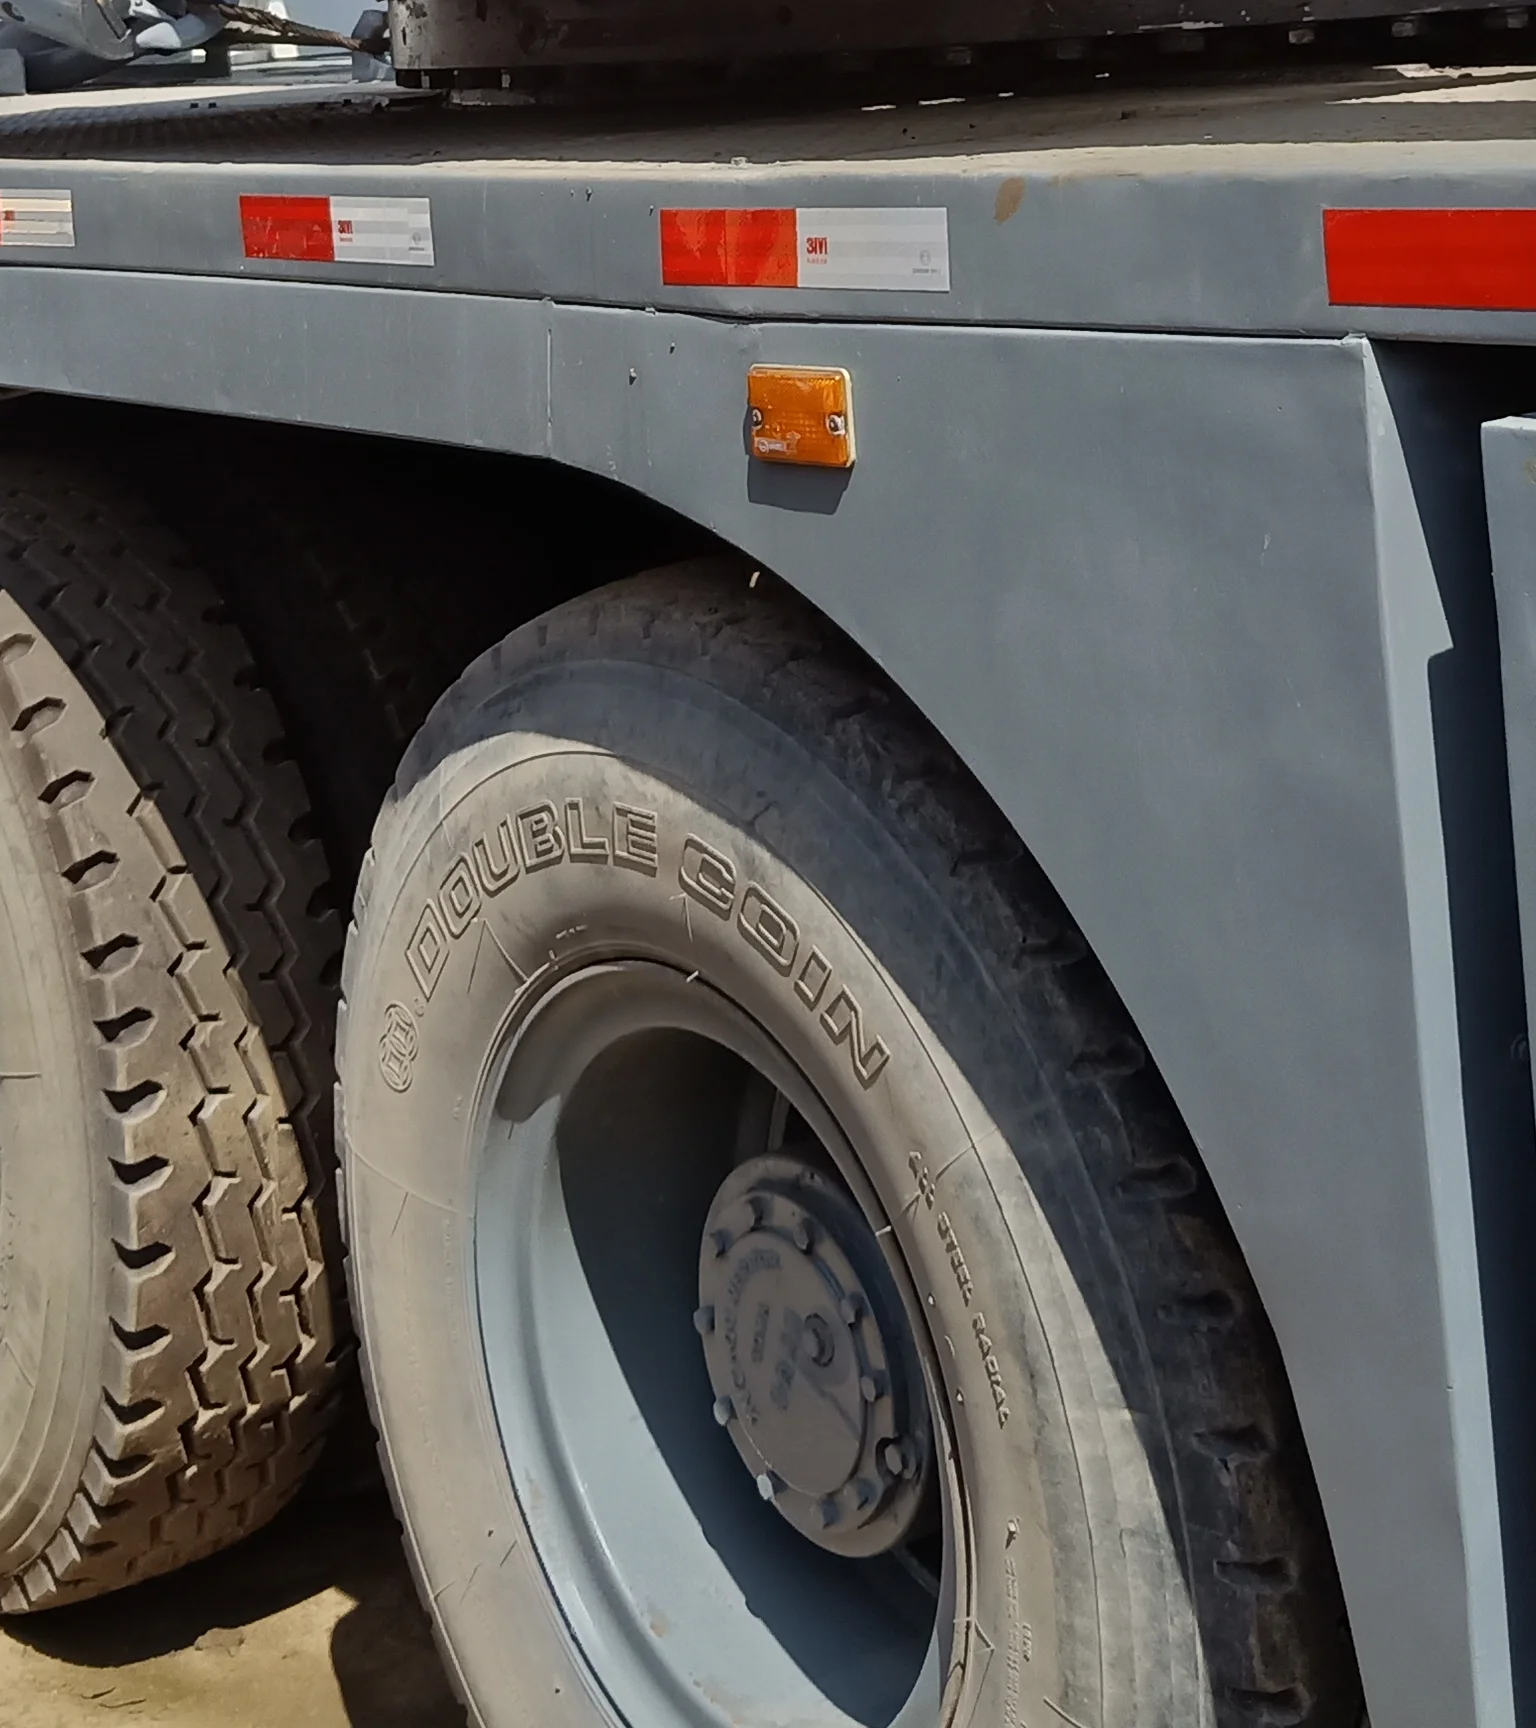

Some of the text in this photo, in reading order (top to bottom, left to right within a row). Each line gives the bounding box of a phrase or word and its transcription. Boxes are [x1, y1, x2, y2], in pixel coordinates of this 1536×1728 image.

[806, 237, 828, 255] 3M
[404, 797, 892, 1090] DOUBLE COIN
[936, 1211, 974, 1308] STEEL
[972, 1311, 1012, 1430] RADIAL
